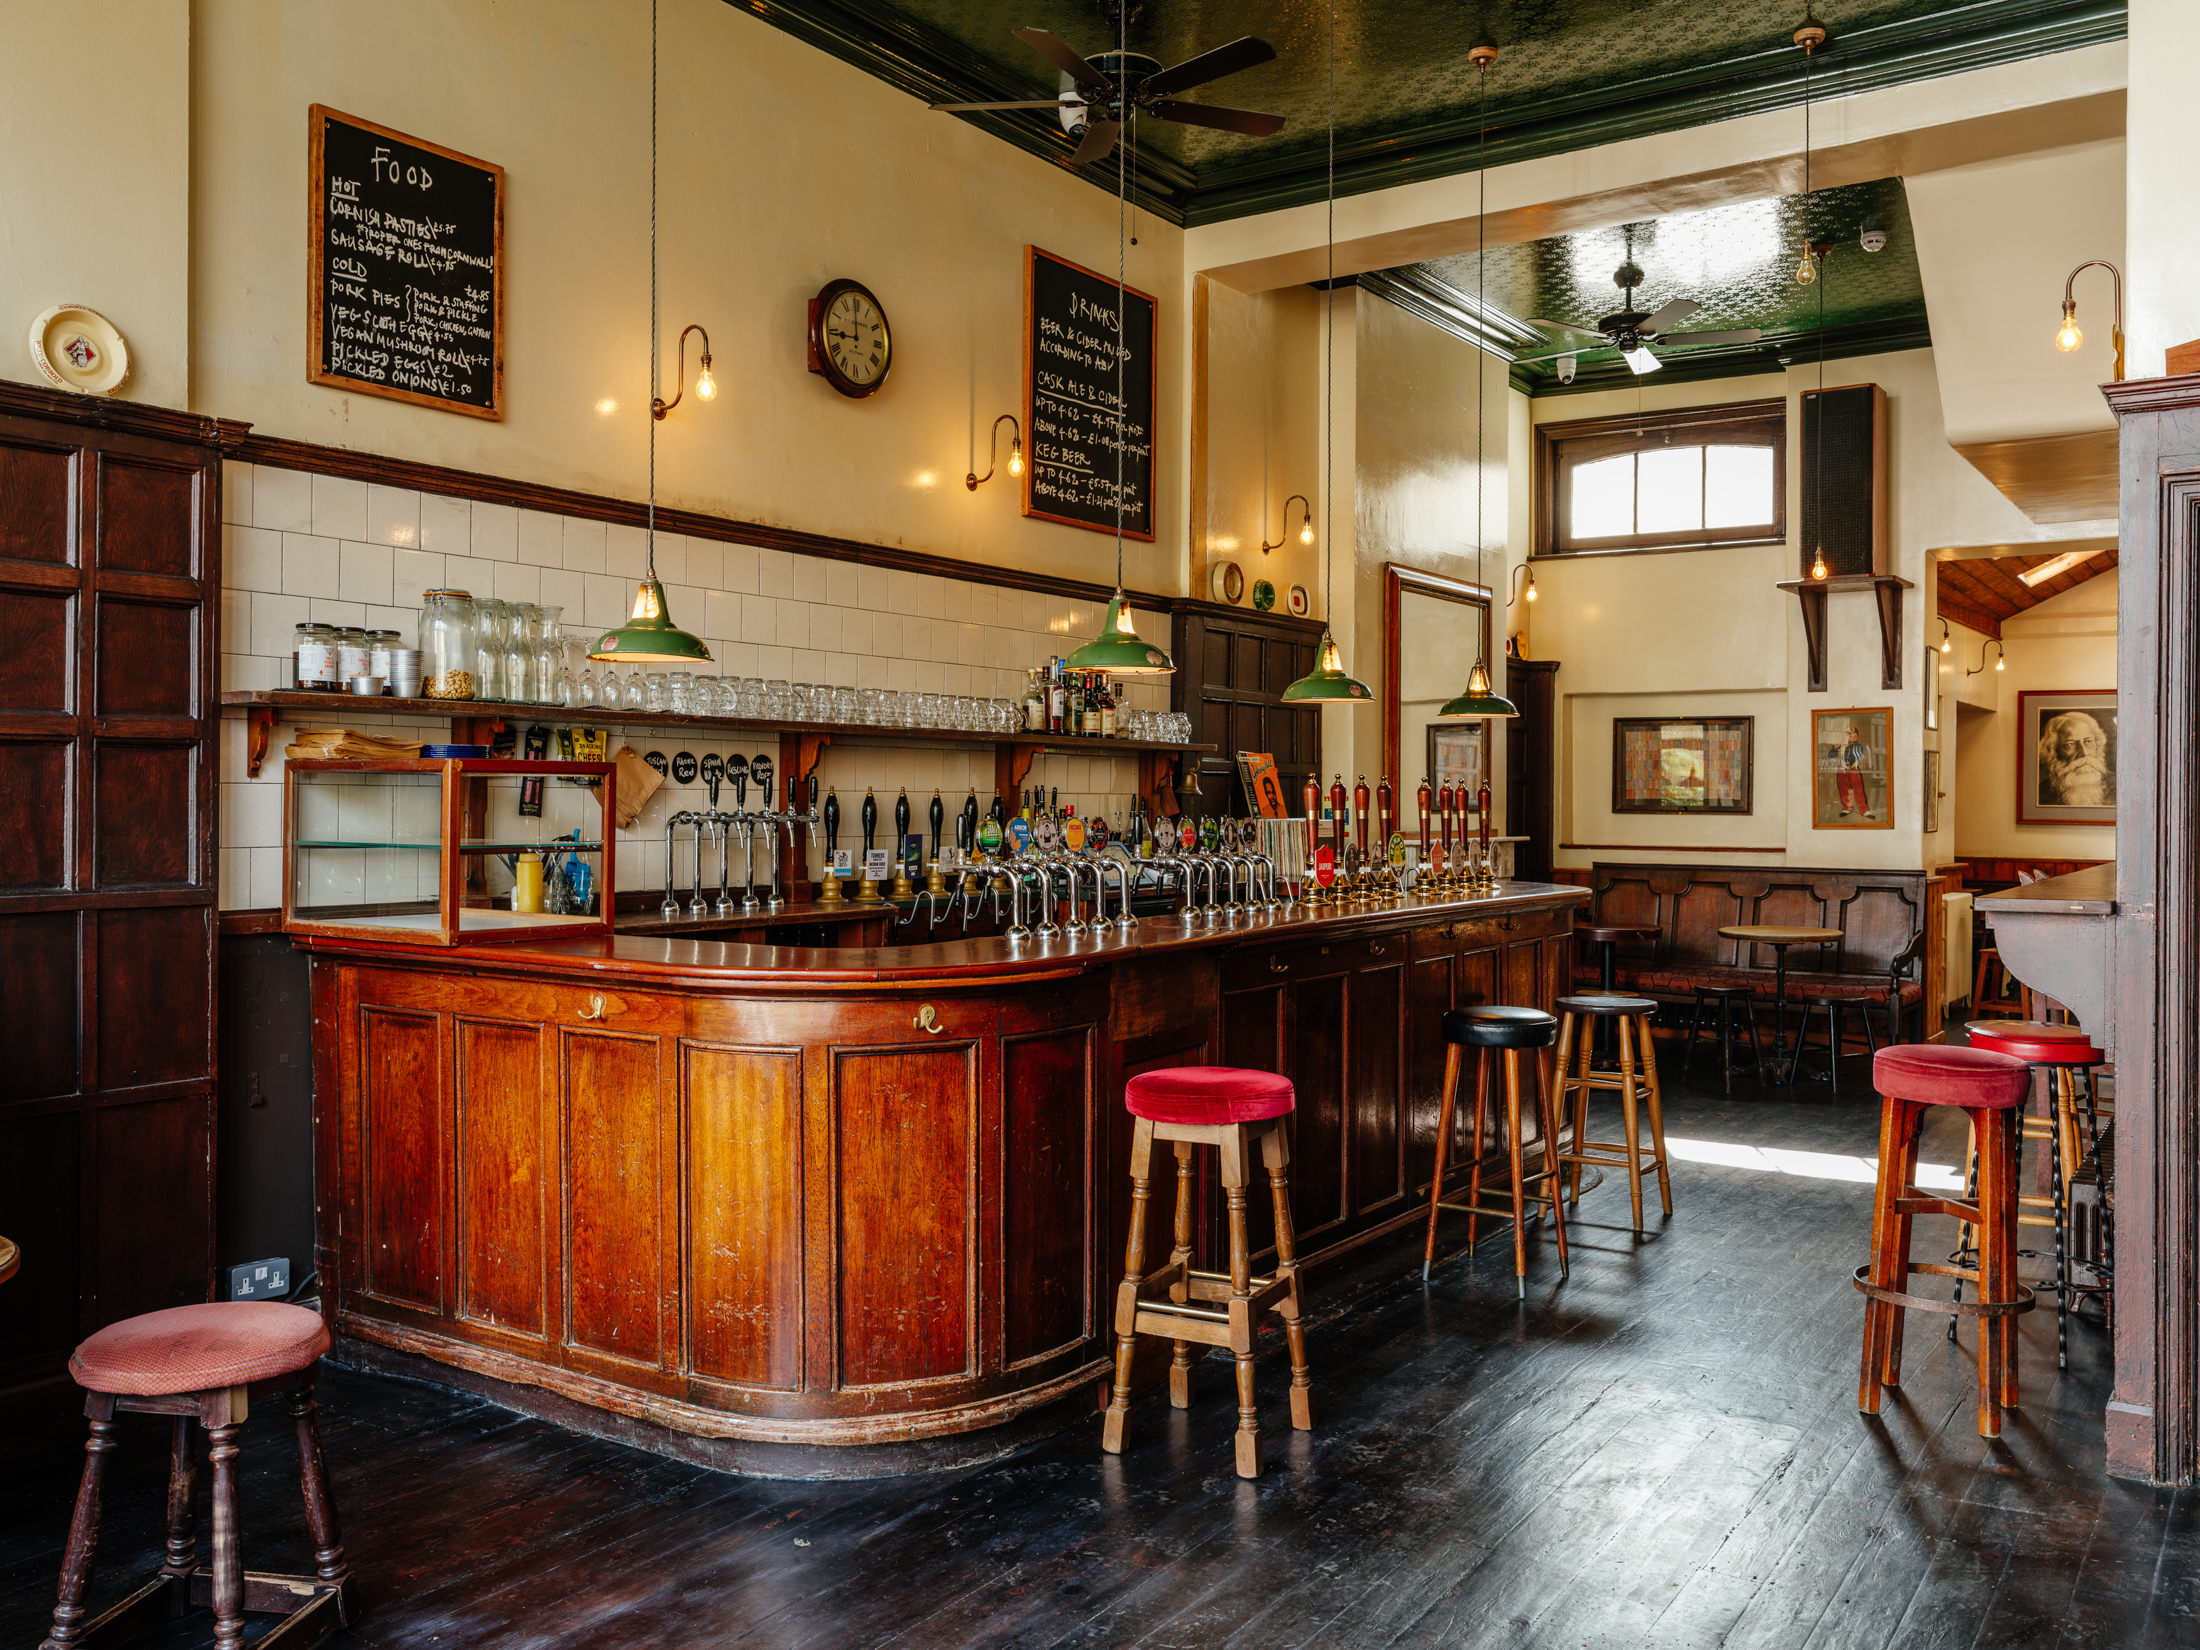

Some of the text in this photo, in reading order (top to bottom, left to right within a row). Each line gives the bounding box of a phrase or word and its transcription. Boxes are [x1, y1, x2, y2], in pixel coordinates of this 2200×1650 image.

[371, 146, 433, 191] FOOD
[331, 176, 361, 197] HOT
[330, 196, 380, 228] CORNISH
[384, 212, 431, 239] PASTIES
[331, 229, 396, 261] SAUSAGE
[398, 248, 428, 268] ROLL
[403, 238, 422, 251] ONES
[447, 249, 493, 274] CORNWALL!
[332, 257, 367, 277] COLD
[330, 278, 401, 309] PORK PIES
[413, 287, 440, 304] PORK
[330, 302, 361, 322] VEG
[399, 320, 426, 341] EGG
[413, 300, 438, 314] PORK
[446, 306, 478, 323] PICKLE
[1069, 292, 1119, 332] DRINKS
[331, 320, 373, 344] VEGAN
[376, 333, 435, 360] MUSHROOM
[1040, 316, 1064, 339] BEER
[1076, 331, 1102, 351] CIDER
[331, 340, 389, 366] PICKLED
[394, 356, 426, 374] EGGS
[1040, 337, 1115, 372] ACCORDING TO ABV
[331, 357, 385, 380] PICKLED
[392, 370, 438, 392] ONIONS
[1037, 370, 1064, 390] CASK
[1067, 379, 1085, 396] ALE
[1088, 384, 1096, 400] &
[1046, 400, 1057, 414] TO
[1034, 417, 1057, 437] ABOVE
[1035, 440, 1090, 465] KEG BEER
[1034, 464, 1045, 478] UP
[1046, 467, 1056, 479] TO
[678, 768, 694, 778] Red
[1318, 862, 1332, 871] JAIPUR
